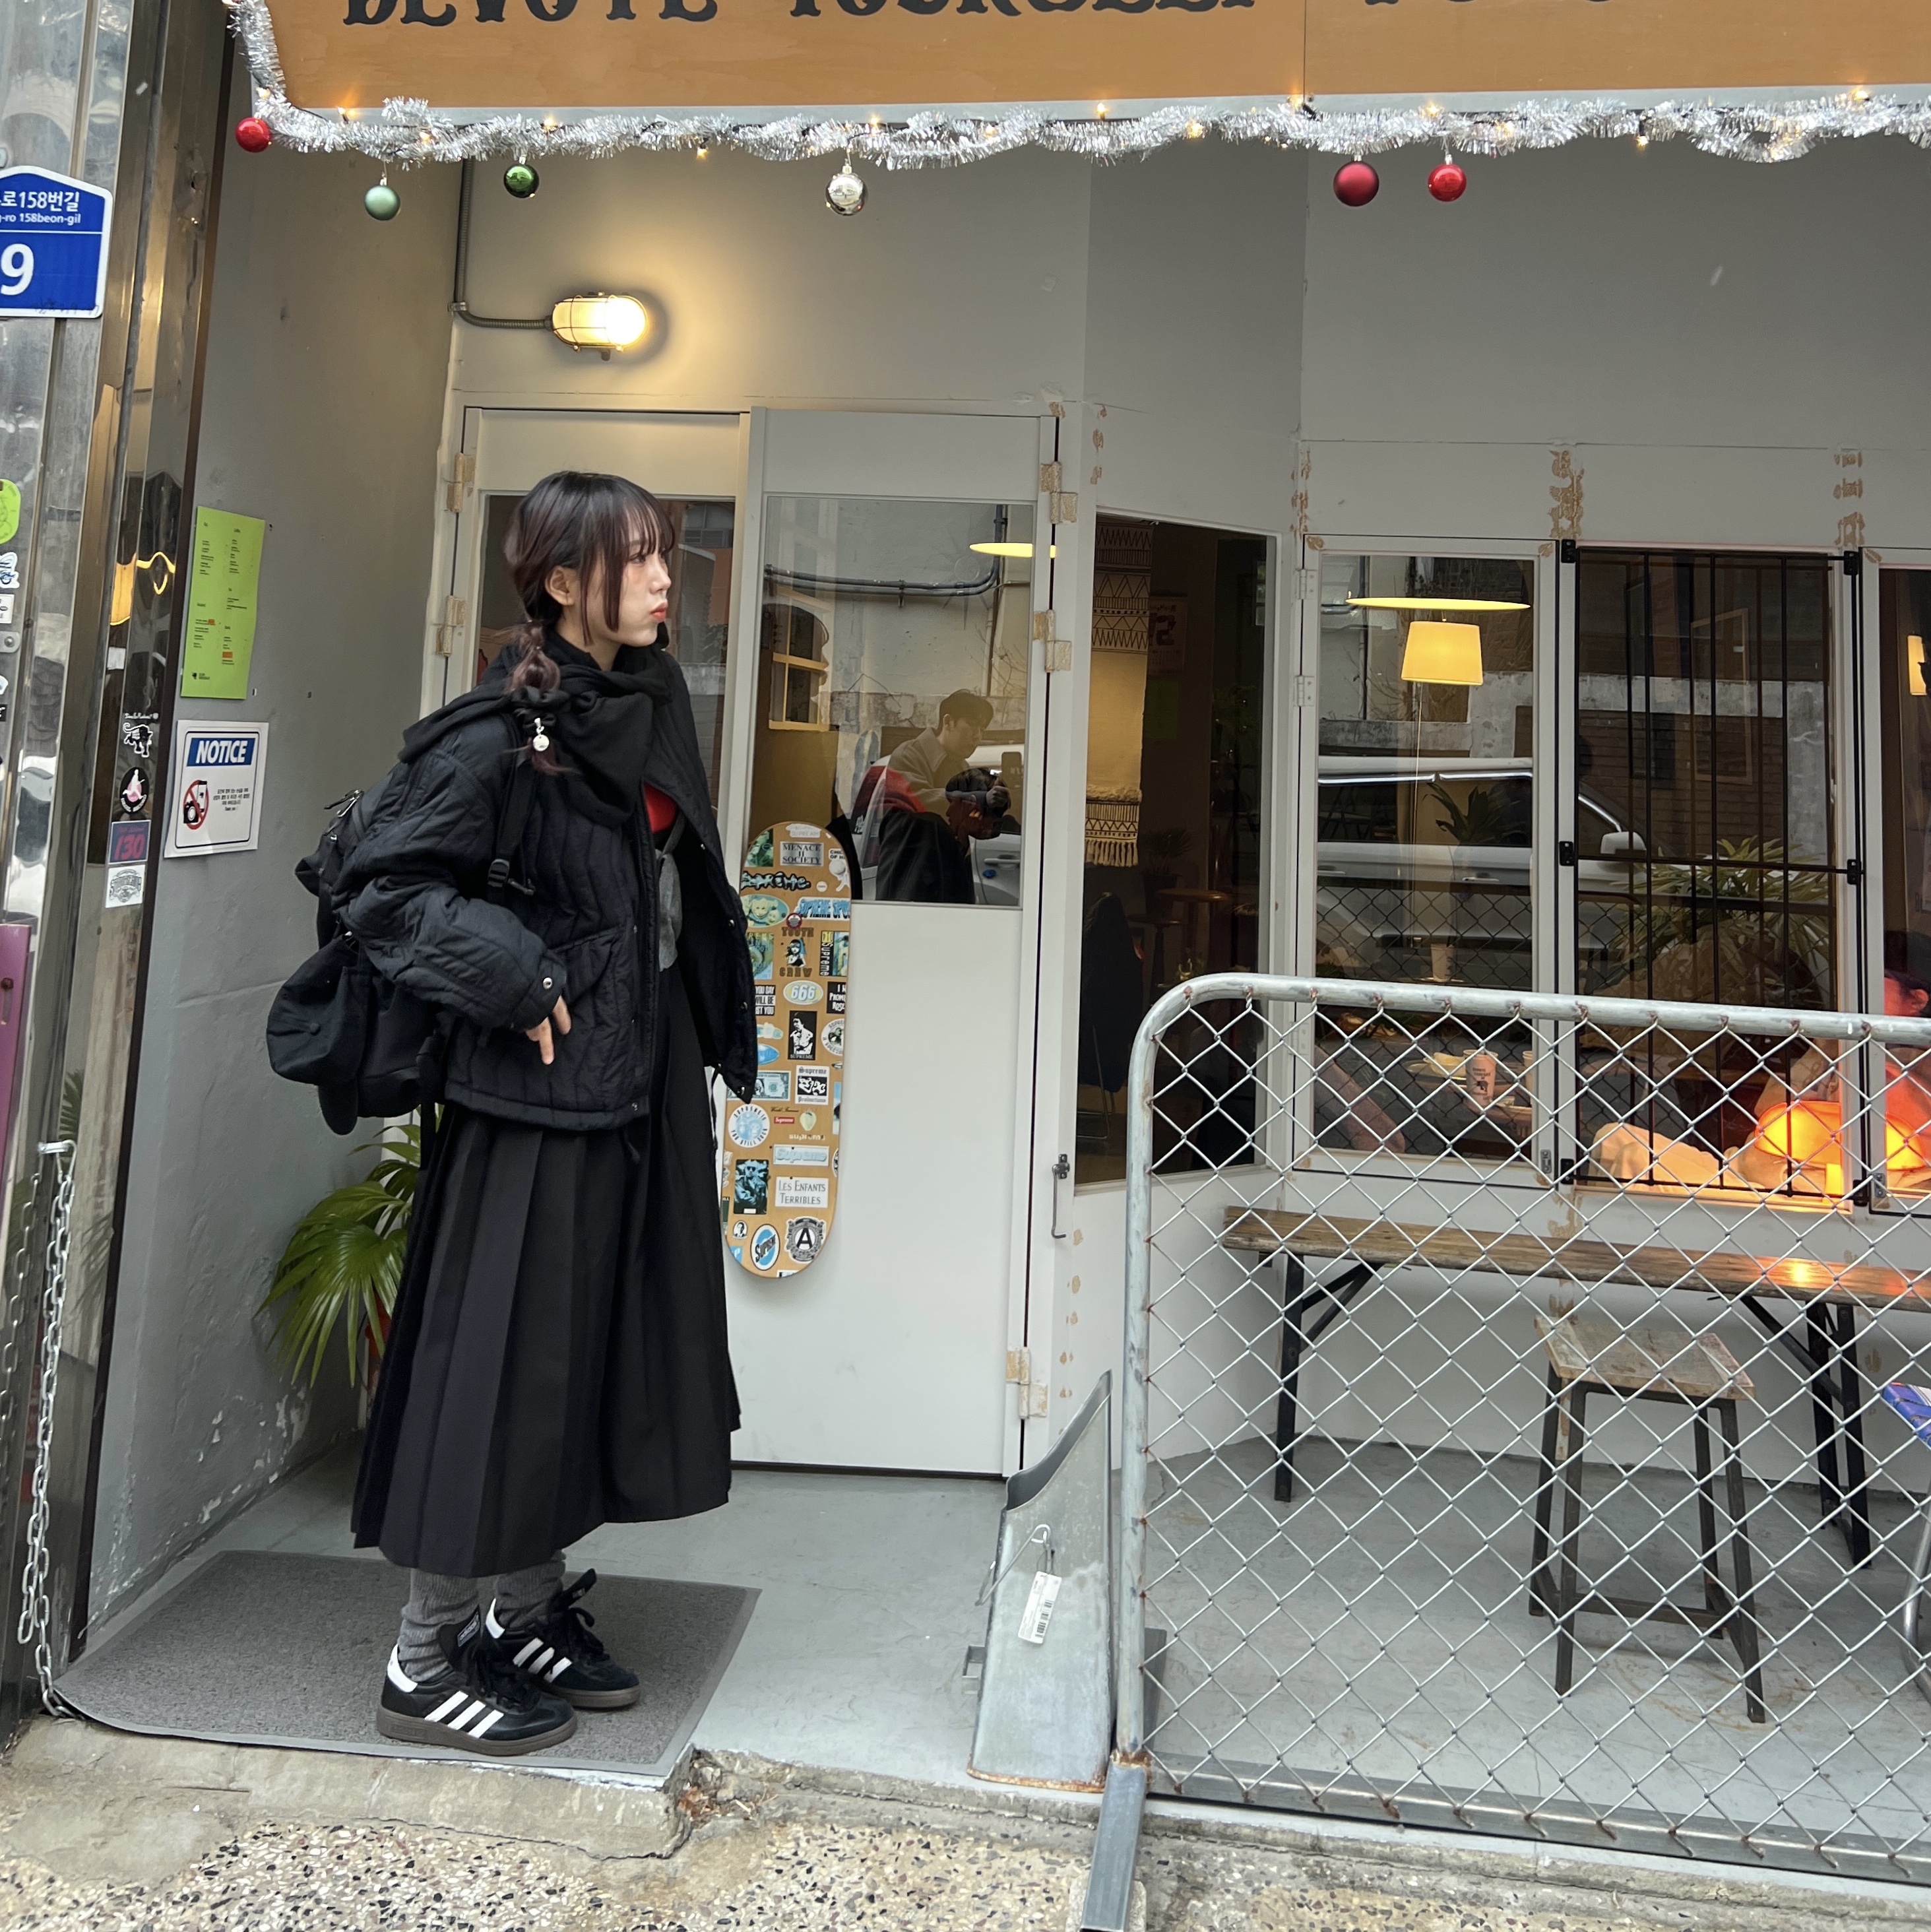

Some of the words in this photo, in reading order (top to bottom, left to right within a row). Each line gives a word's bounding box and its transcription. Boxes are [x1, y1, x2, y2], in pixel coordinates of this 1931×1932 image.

[0, 191, 80, 212] 로158번길
[0, 214, 16, 222] -ro
[20, 213, 81, 226] 158beon-gil
[1, 243, 34, 296] 9
[196, 740, 248, 764] NOTICE
[114, 833, 145, 860] 130
[782, 927, 814, 937] YOUTH
[820, 942, 833, 976] Supreme
[779, 967, 812, 977] CREW
[791, 984, 816, 1001] 666
[796, 1228, 813, 1250] A
